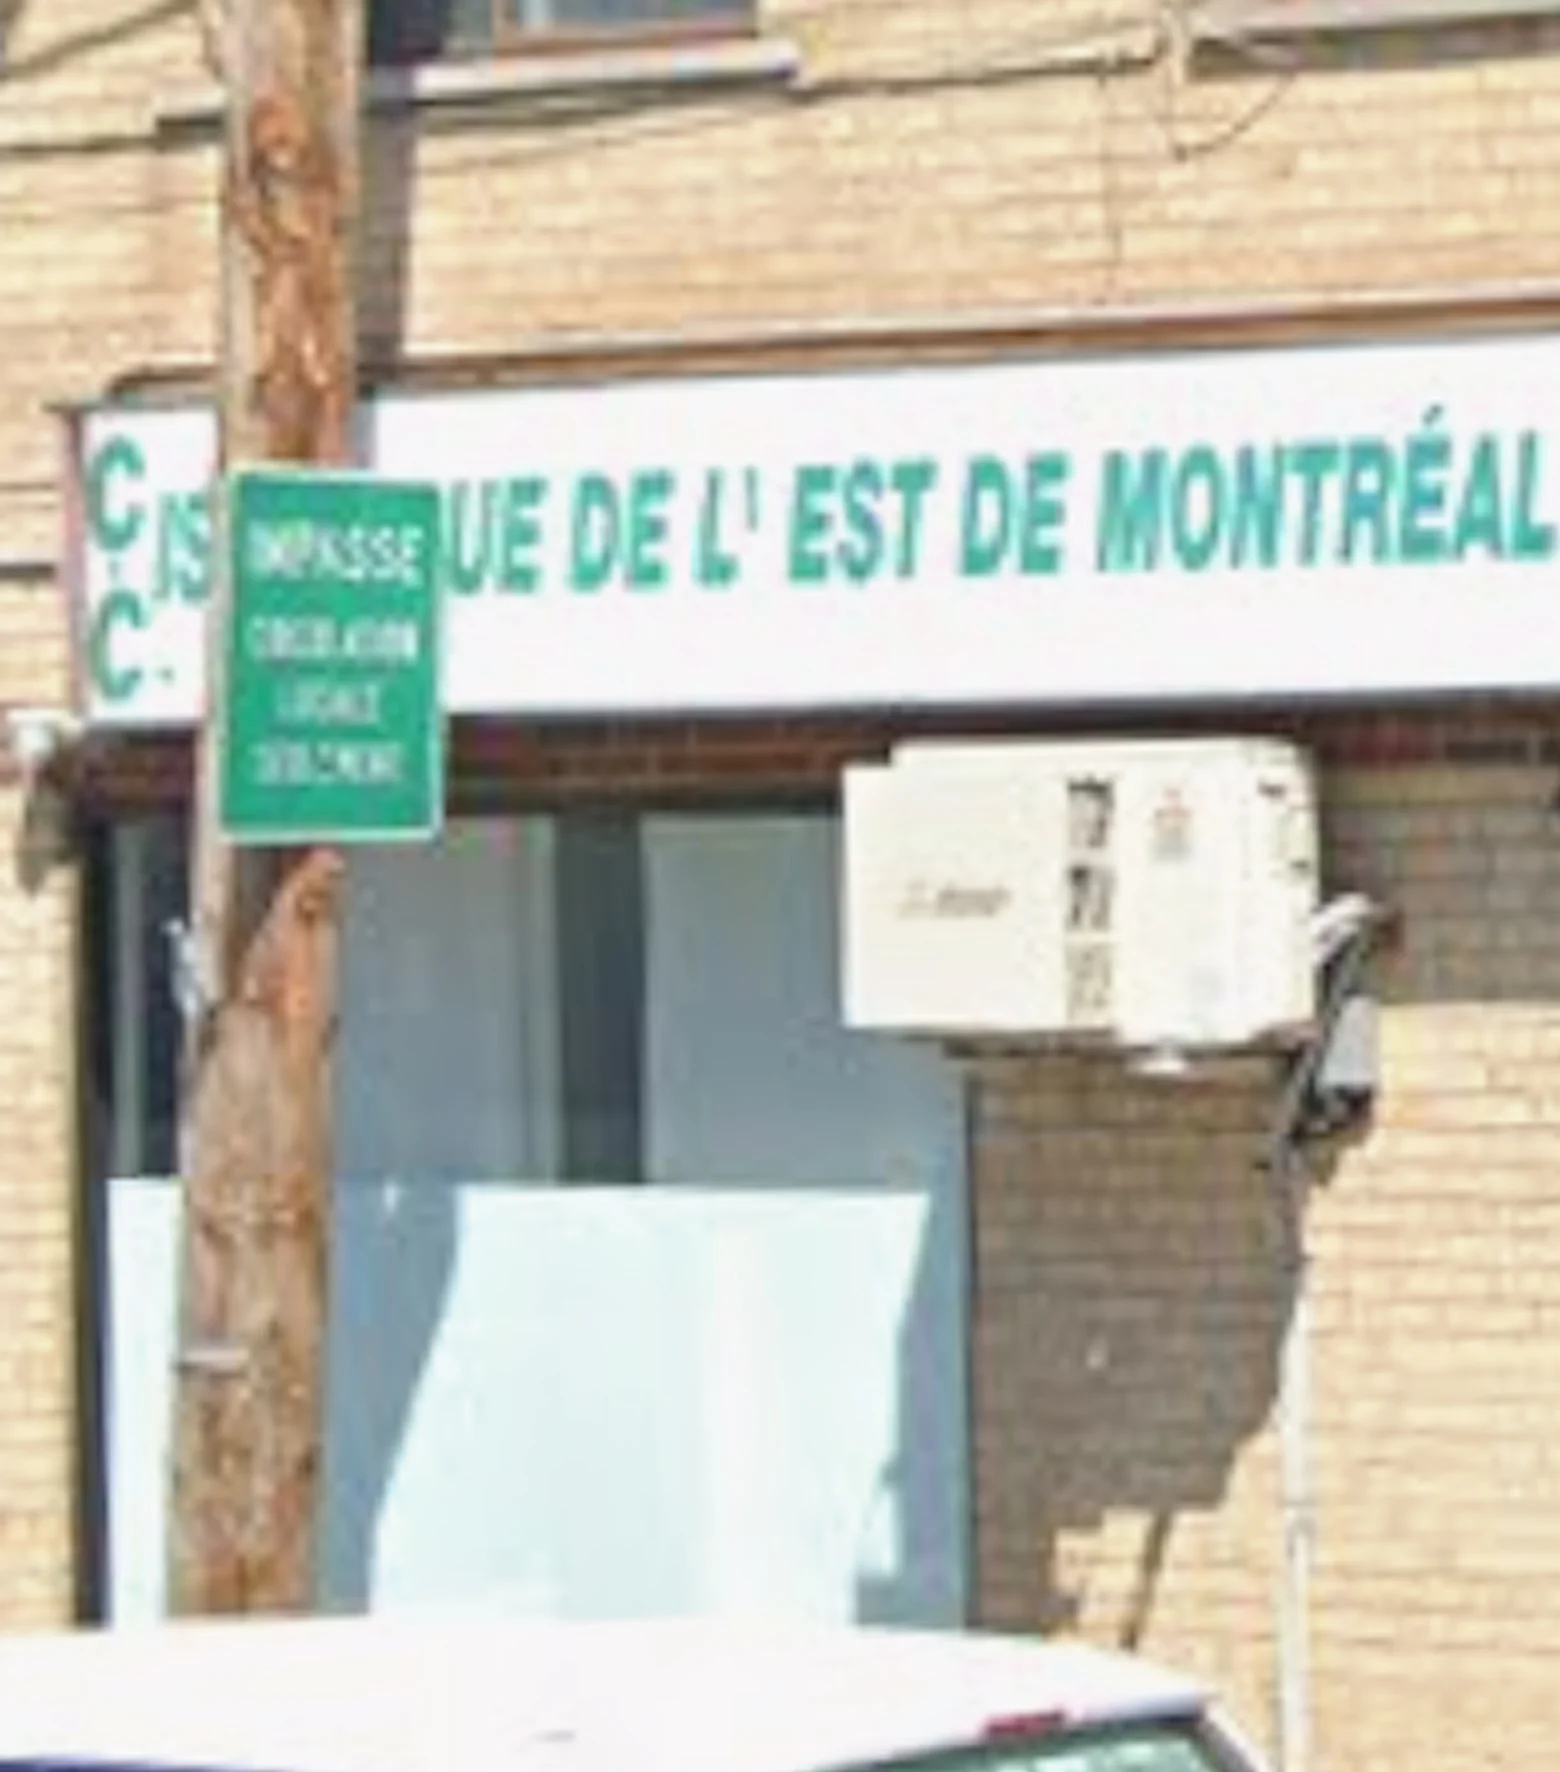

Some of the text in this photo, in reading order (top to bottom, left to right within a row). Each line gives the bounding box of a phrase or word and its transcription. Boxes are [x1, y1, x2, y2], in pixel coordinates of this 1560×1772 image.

[248, 519, 425, 586] IMPASSE
[568, 470, 674, 592] DE
[786, 459, 938, 587] EST
[959, 451, 1072, 577] DE
[1096, 405, 1556, 573] MONTRÉAL
